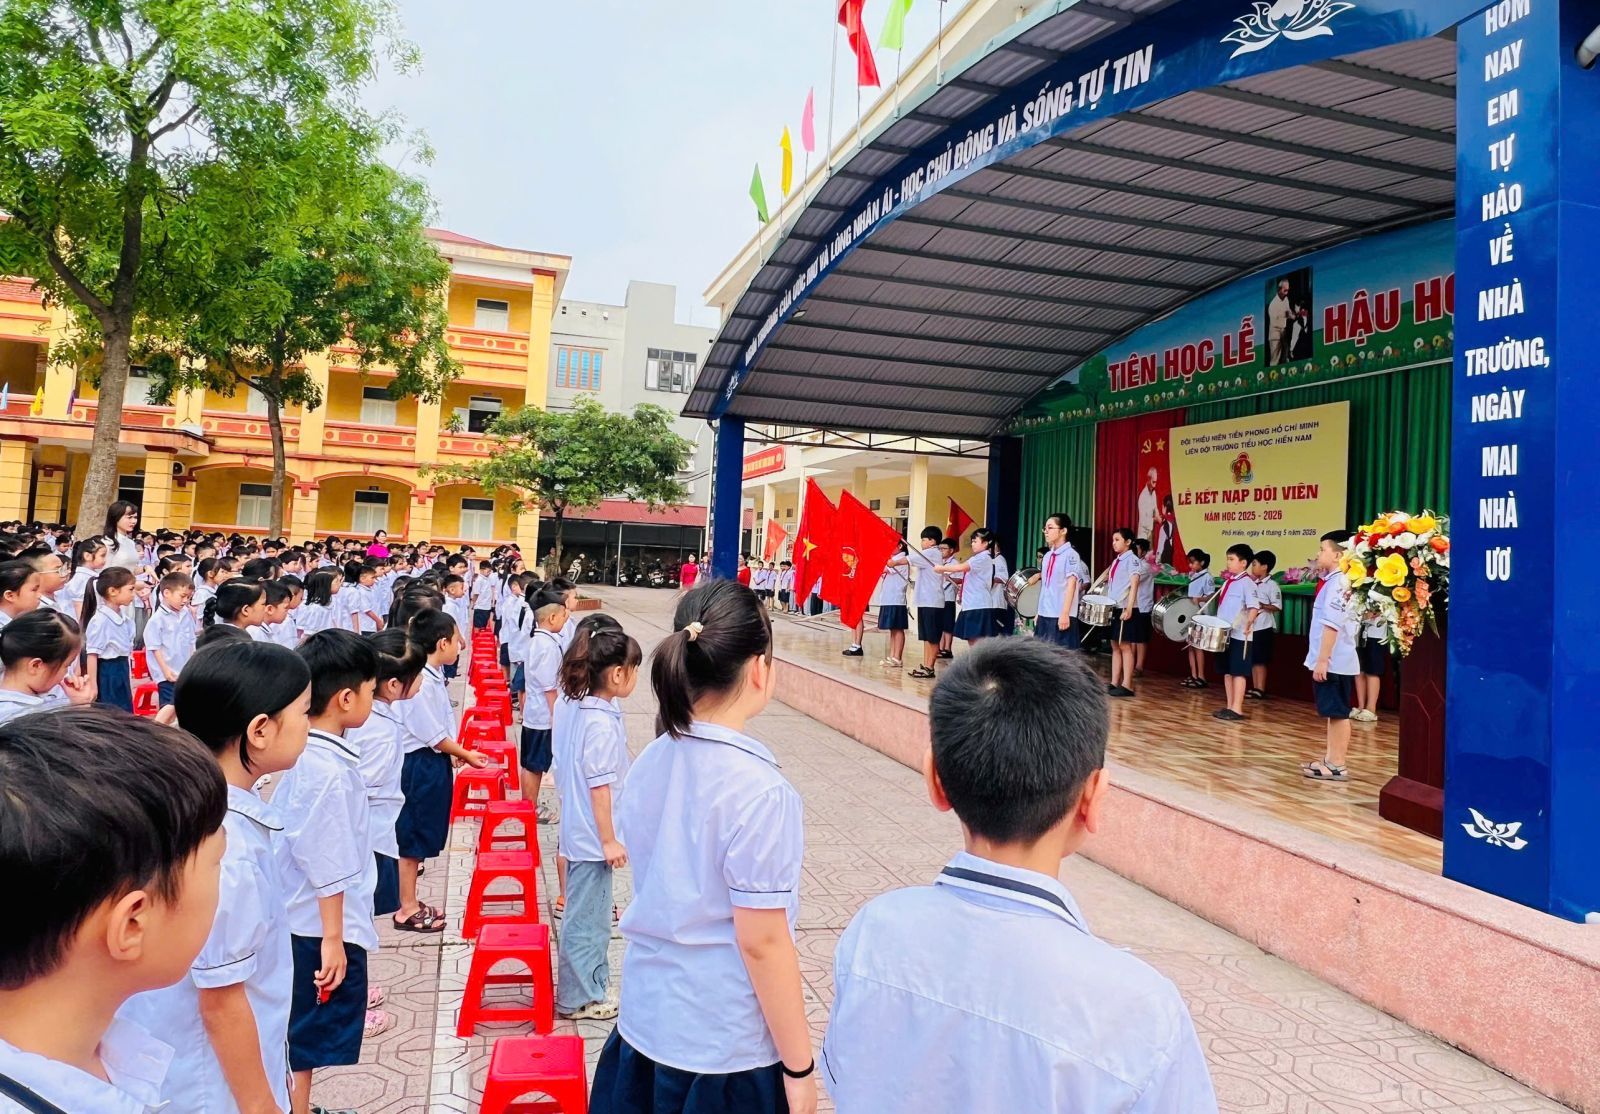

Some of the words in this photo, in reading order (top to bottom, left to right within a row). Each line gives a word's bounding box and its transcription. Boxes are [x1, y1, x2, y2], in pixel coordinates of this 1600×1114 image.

[1484, 39, 1523, 82] NAY
[1487, 88, 1518, 127] EM
[830, 225, 852, 261] LÒNG
[853, 198, 880, 240] NHÂN
[881, 186, 893, 217] ÁI
[901, 167, 924, 203] HỌC
[926, 141, 953, 185] CHỦ
[953, 123, 995, 170] ĐỘNG
[997, 104, 1017, 145] VÀ
[1021, 80, 1074, 133] SỐNG
[1078, 59, 1110, 111] TỰ
[1113, 44, 1154, 95] TIN
[1488, 133, 1515, 173] TỰ
[1482, 182, 1522, 222] HÀO
[1489, 222, 1514, 266] VỀ
[1478, 277, 1524, 322] NHÀ
[1108, 352, 1157, 392] TIÊN
[1164, 338, 1215, 384] HỌC
[1222, 314, 1256, 368] LỄ
[1323, 288, 1401, 347] HẬU
[1465, 336, 1550, 377] TRƯỜNG,
[1471, 386, 1526, 423] NGÀY
[1245, 427, 1270, 437] PHONG
[1299, 421, 1319, 430] MINH
[1295, 434, 1312, 442] NAM
[1482, 444, 1518, 477] MAI
[1195, 485, 1219, 505] KẾT
[1222, 488, 1250, 506] NẠP
[1254, 484, 1278, 504] ĐỘI
[1282, 482, 1319, 500] VIÊN
[1479, 490, 1518, 529] NHÀ
[1237, 511, 1256, 521] 2025
[1263, 510, 1283, 521] 2026
[1485, 546, 1512, 581] ƯƠ
